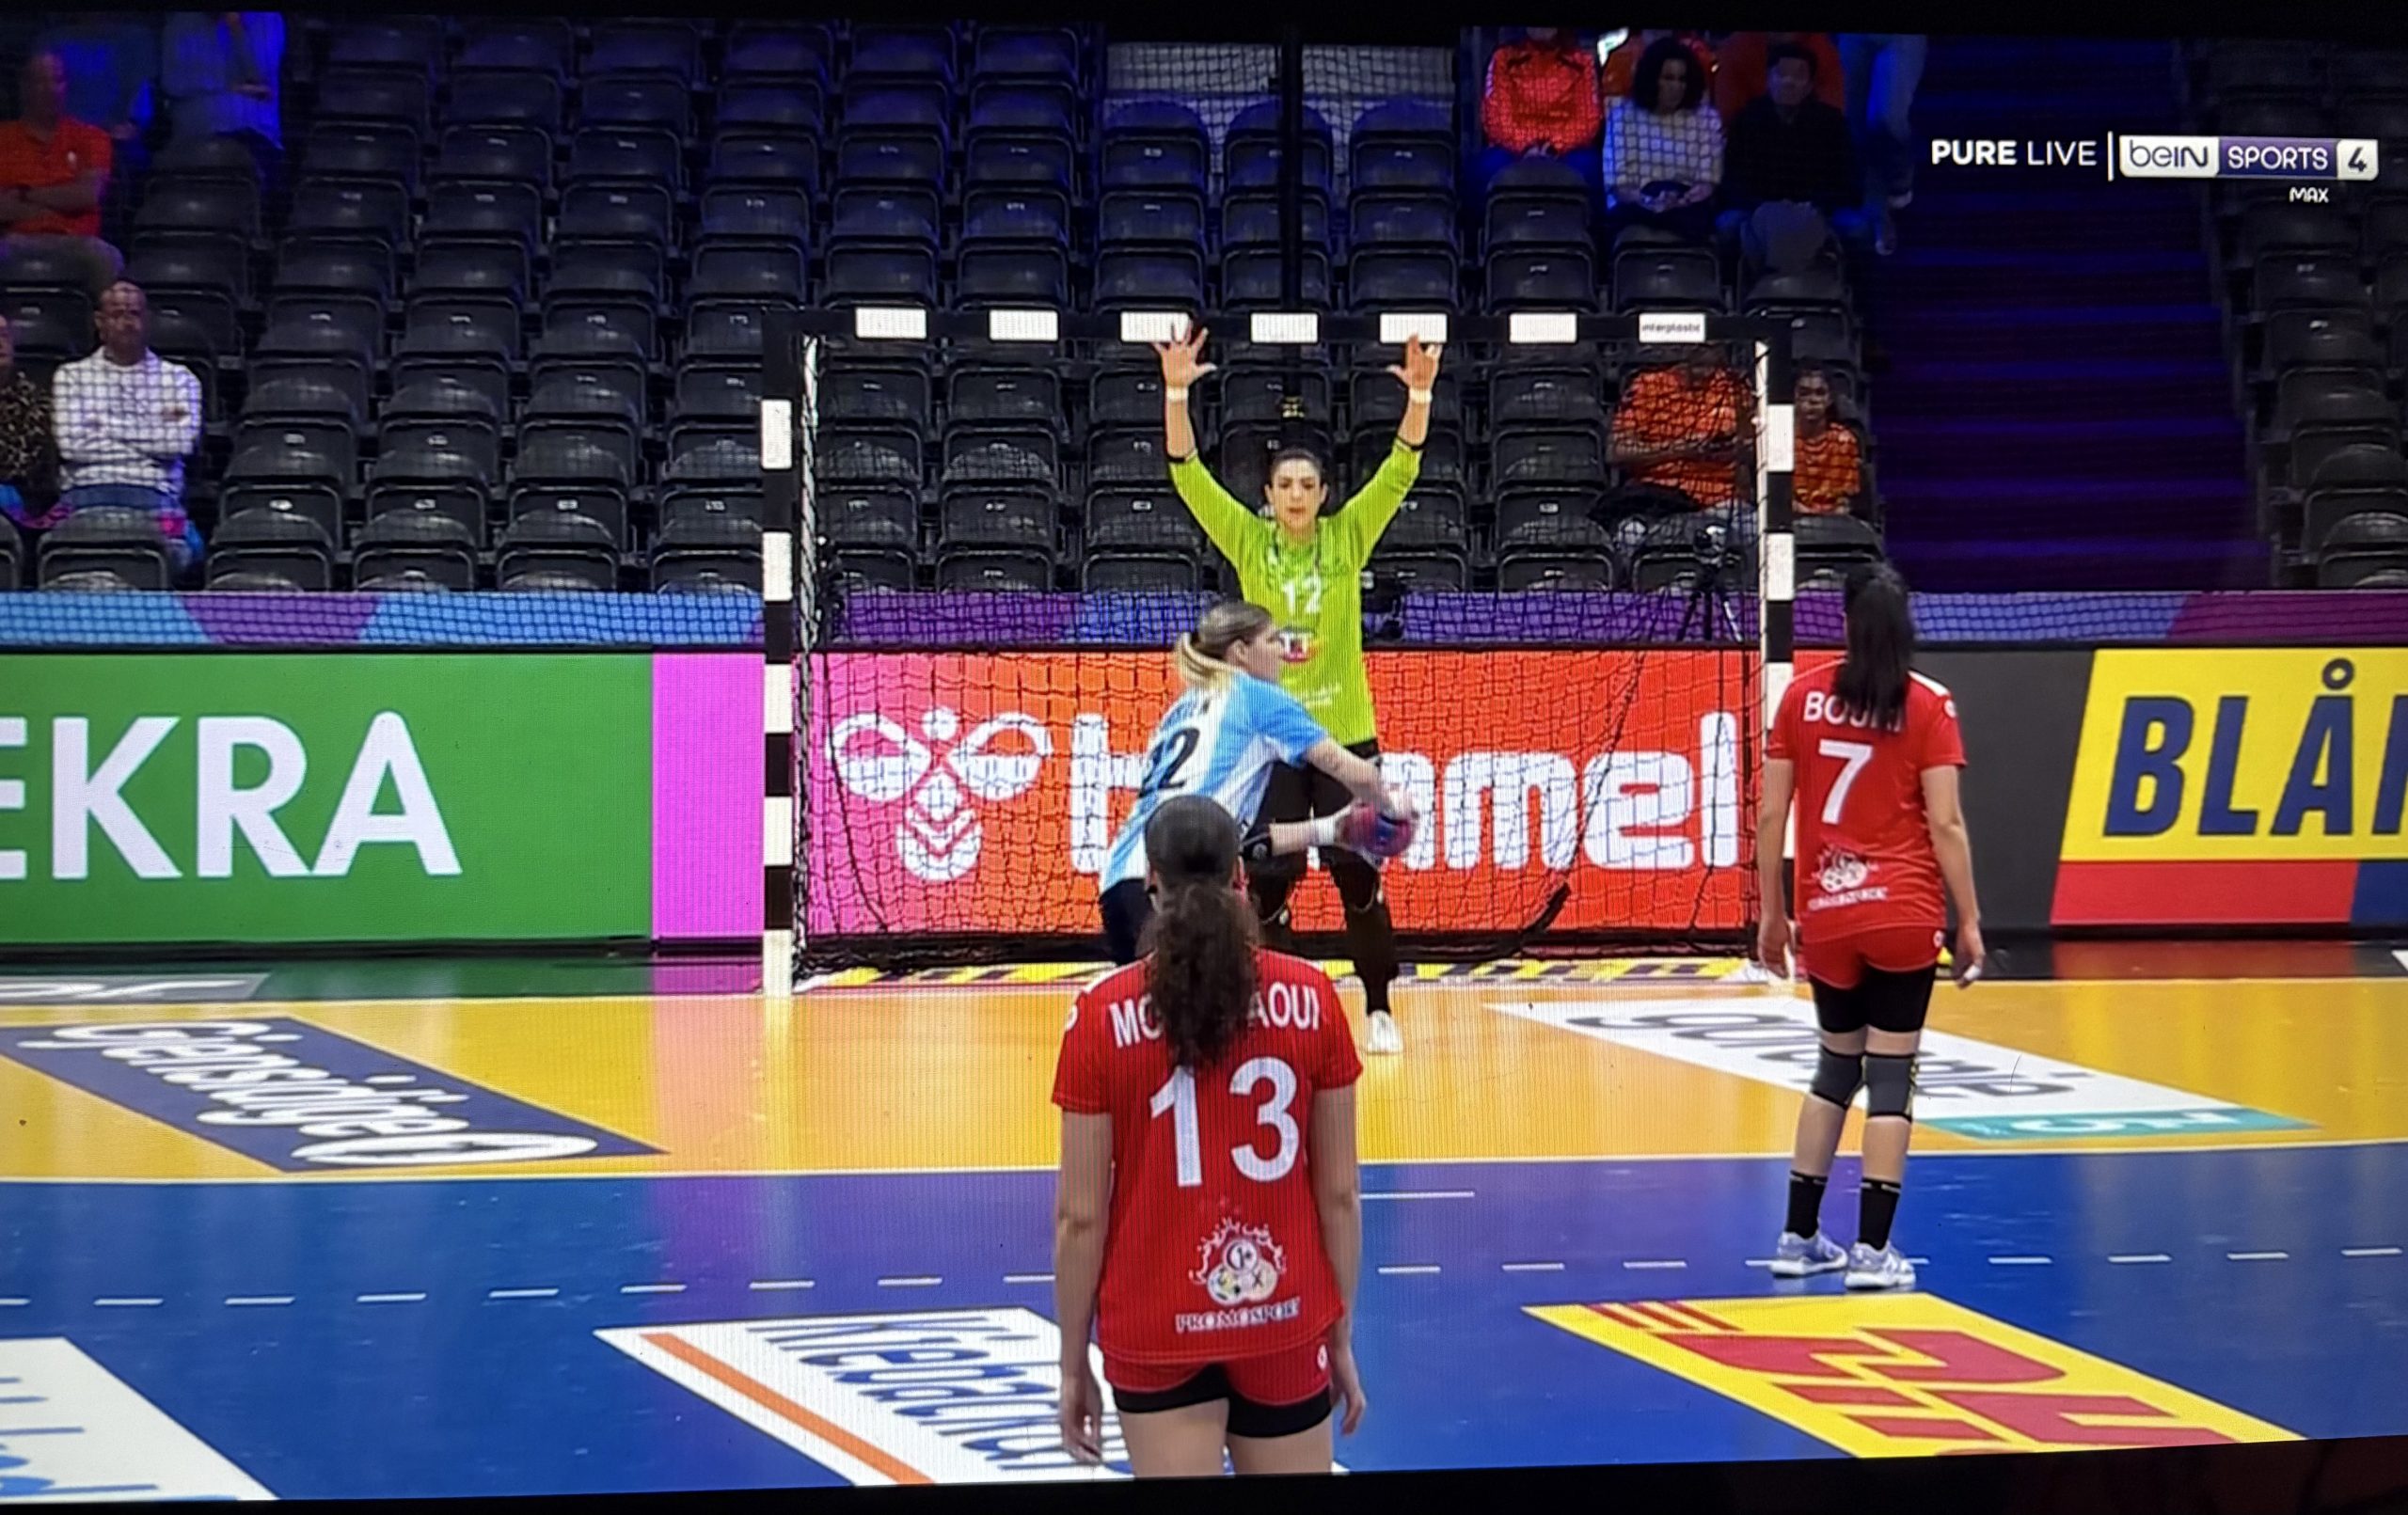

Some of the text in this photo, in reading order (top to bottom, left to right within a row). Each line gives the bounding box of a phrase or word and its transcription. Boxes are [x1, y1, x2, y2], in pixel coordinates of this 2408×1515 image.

[1282, 573, 1323, 615] 12
[1818, 738, 1874, 825] 7
[1149, 1056, 1300, 1188] 13
[1651, 1327, 2244, 1454] DH
